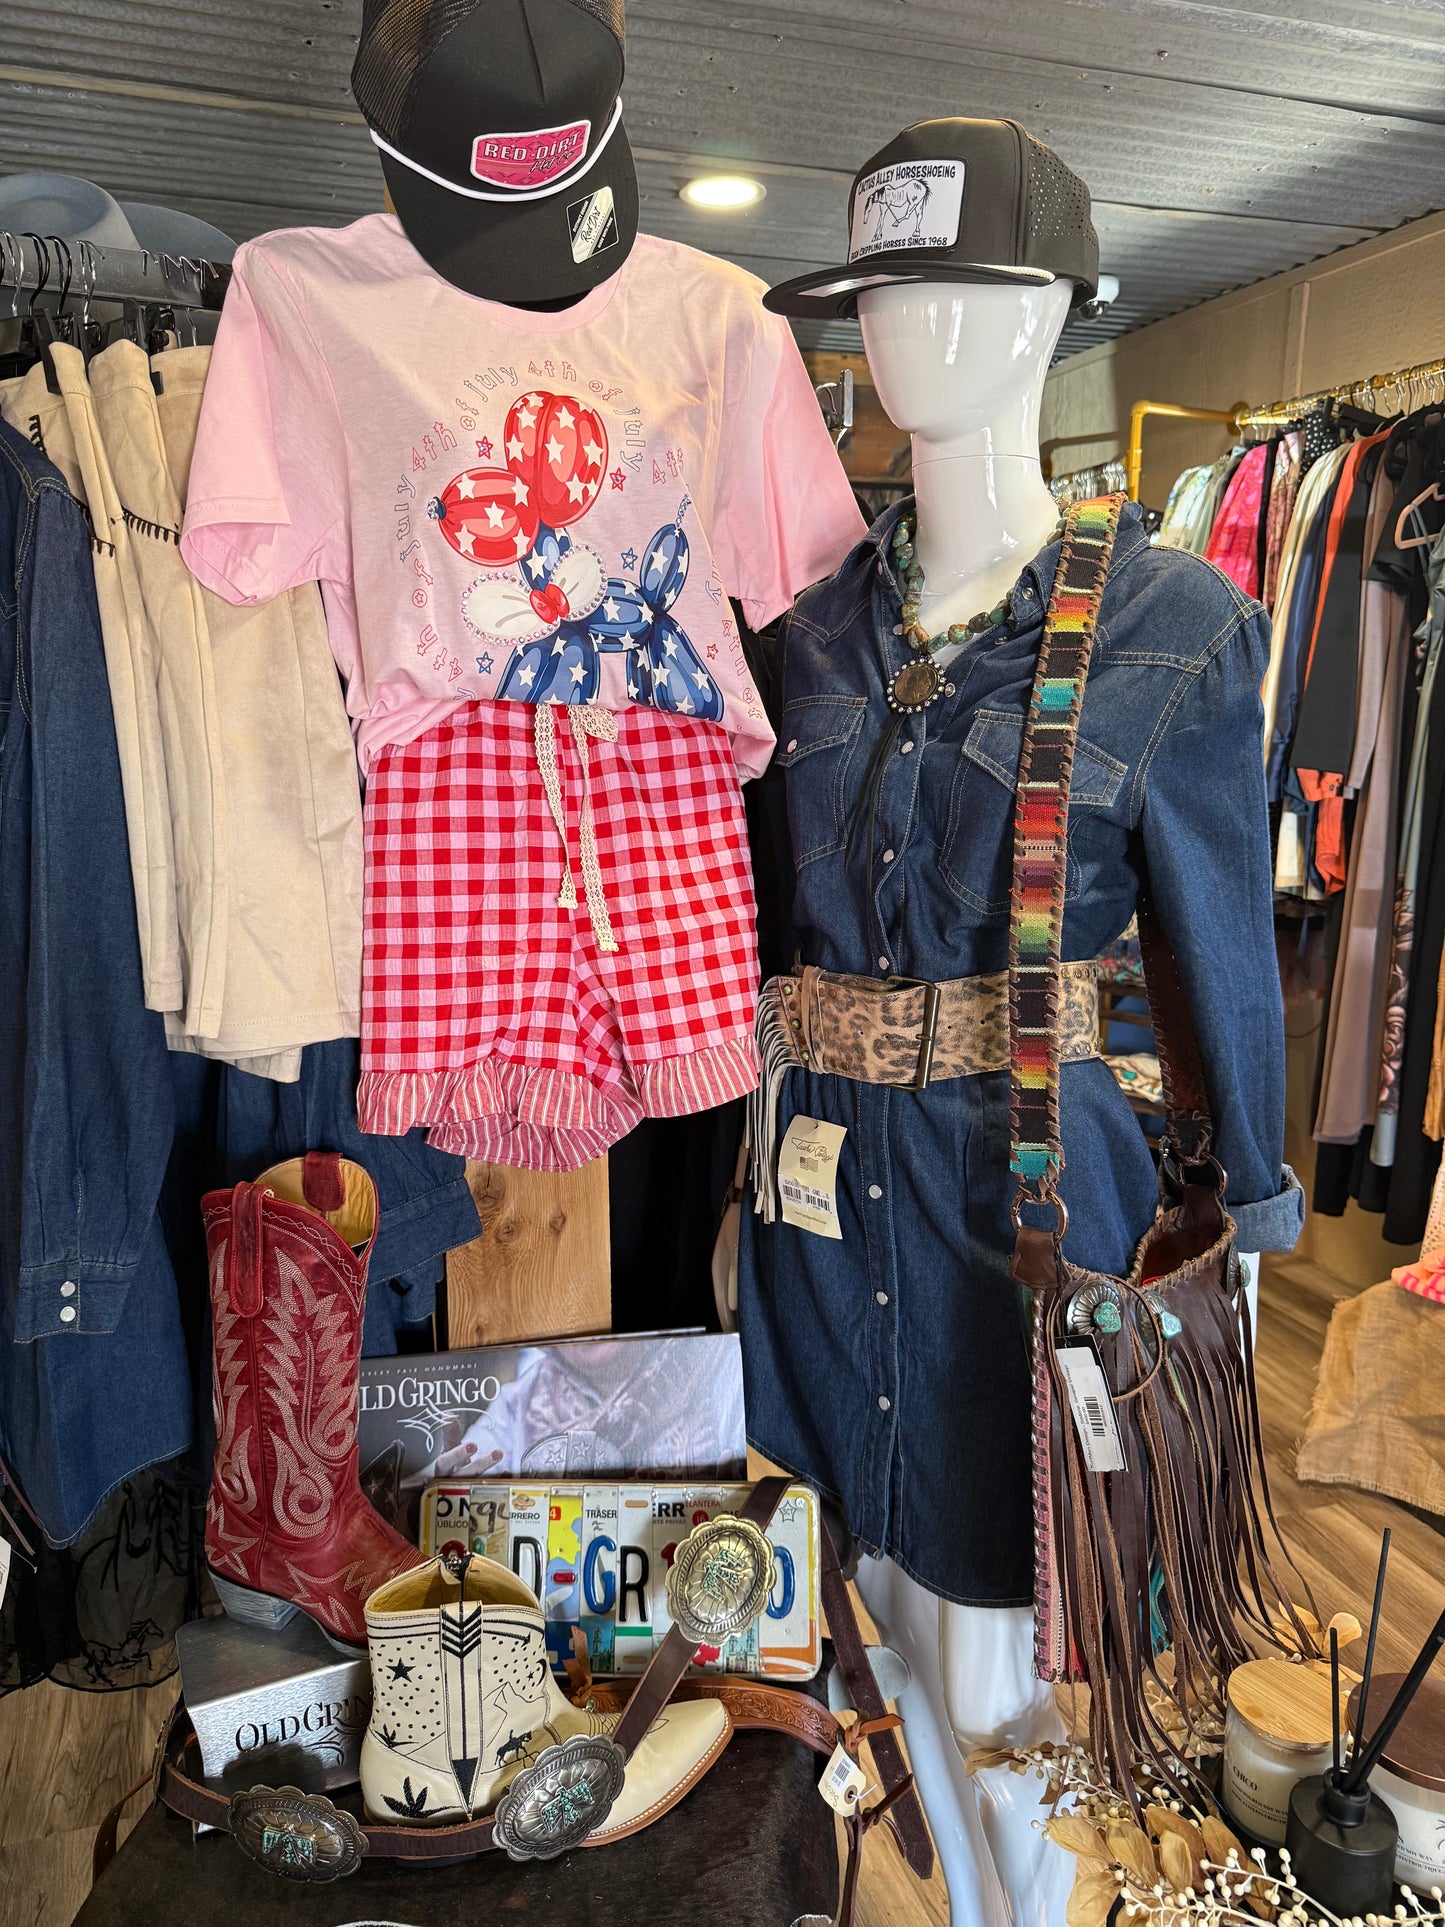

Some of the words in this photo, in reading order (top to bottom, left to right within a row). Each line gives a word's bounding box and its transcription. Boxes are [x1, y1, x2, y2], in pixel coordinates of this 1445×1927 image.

[484, 143, 528, 161] RED
[535, 131, 581, 160] DIRT
[530, 155, 556, 172] Hat
[858, 177, 875, 195] CACTUS
[875, 168, 895, 185] ALLEY
[896, 165, 956, 181] HORSESHOEING
[883, 238, 906, 250] HORSES
[907, 237, 927, 247] SINCE
[928, 237, 948, 247] 1968
[463, 365, 519, 402] july
[528, 360, 578, 382] 4th
[588, 379, 624, 402] of
[455, 397, 480, 431] of
[412, 421, 457, 472] 4th
[613, 406, 646, 473] july
[424, 1363, 478, 1372] HANDMADE
[360, 1384, 396, 1411] LD
[398, 1376, 500, 1410] GRINGO
[235, 1715, 300, 1752] OLD
